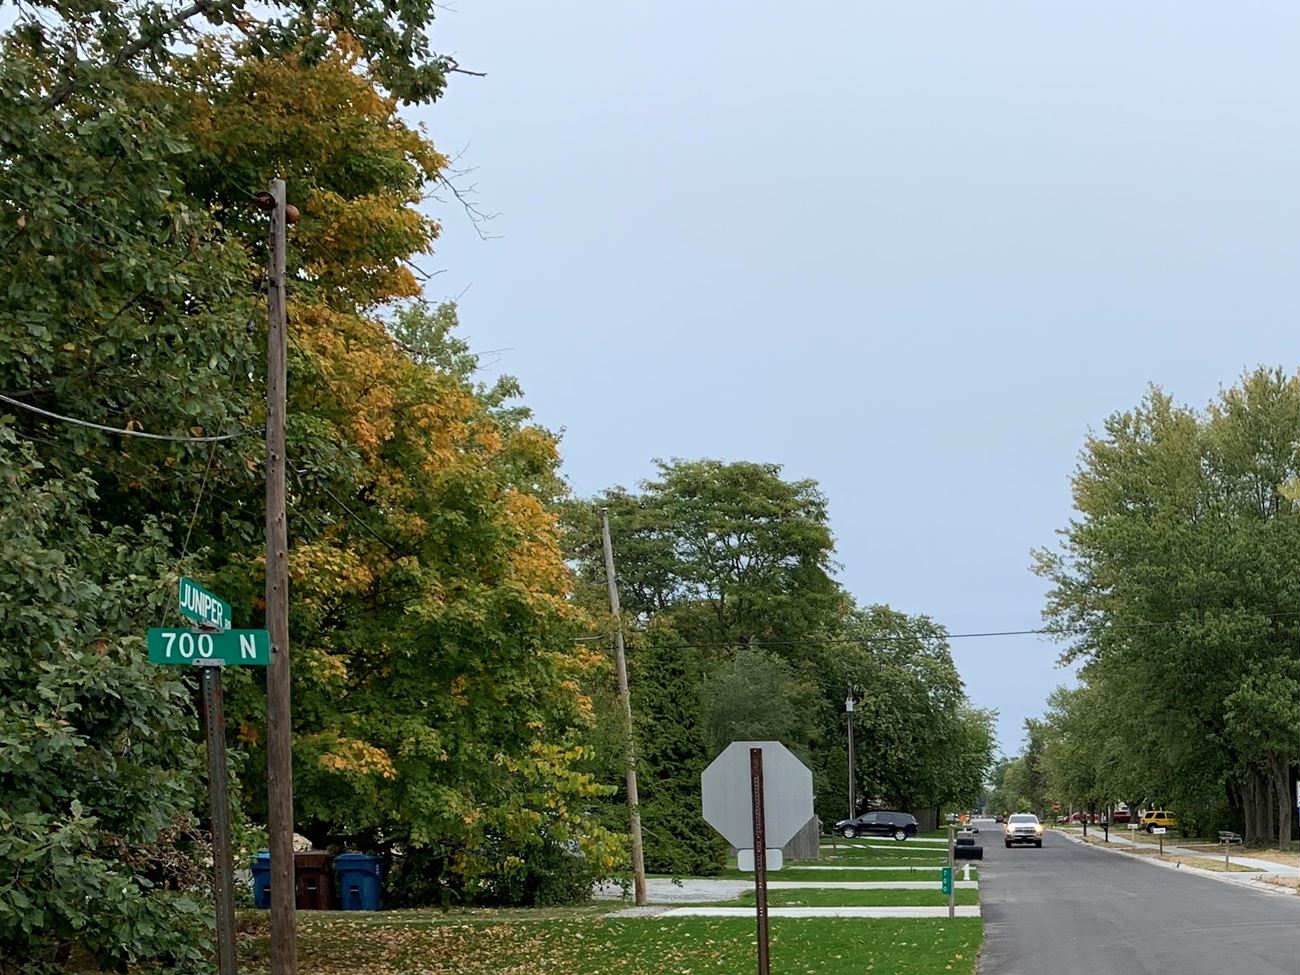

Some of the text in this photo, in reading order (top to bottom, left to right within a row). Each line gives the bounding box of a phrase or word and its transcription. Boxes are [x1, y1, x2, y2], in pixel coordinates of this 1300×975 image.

[181, 584, 223, 627] JUNIPER
[162, 633, 256, 659] 700 N
